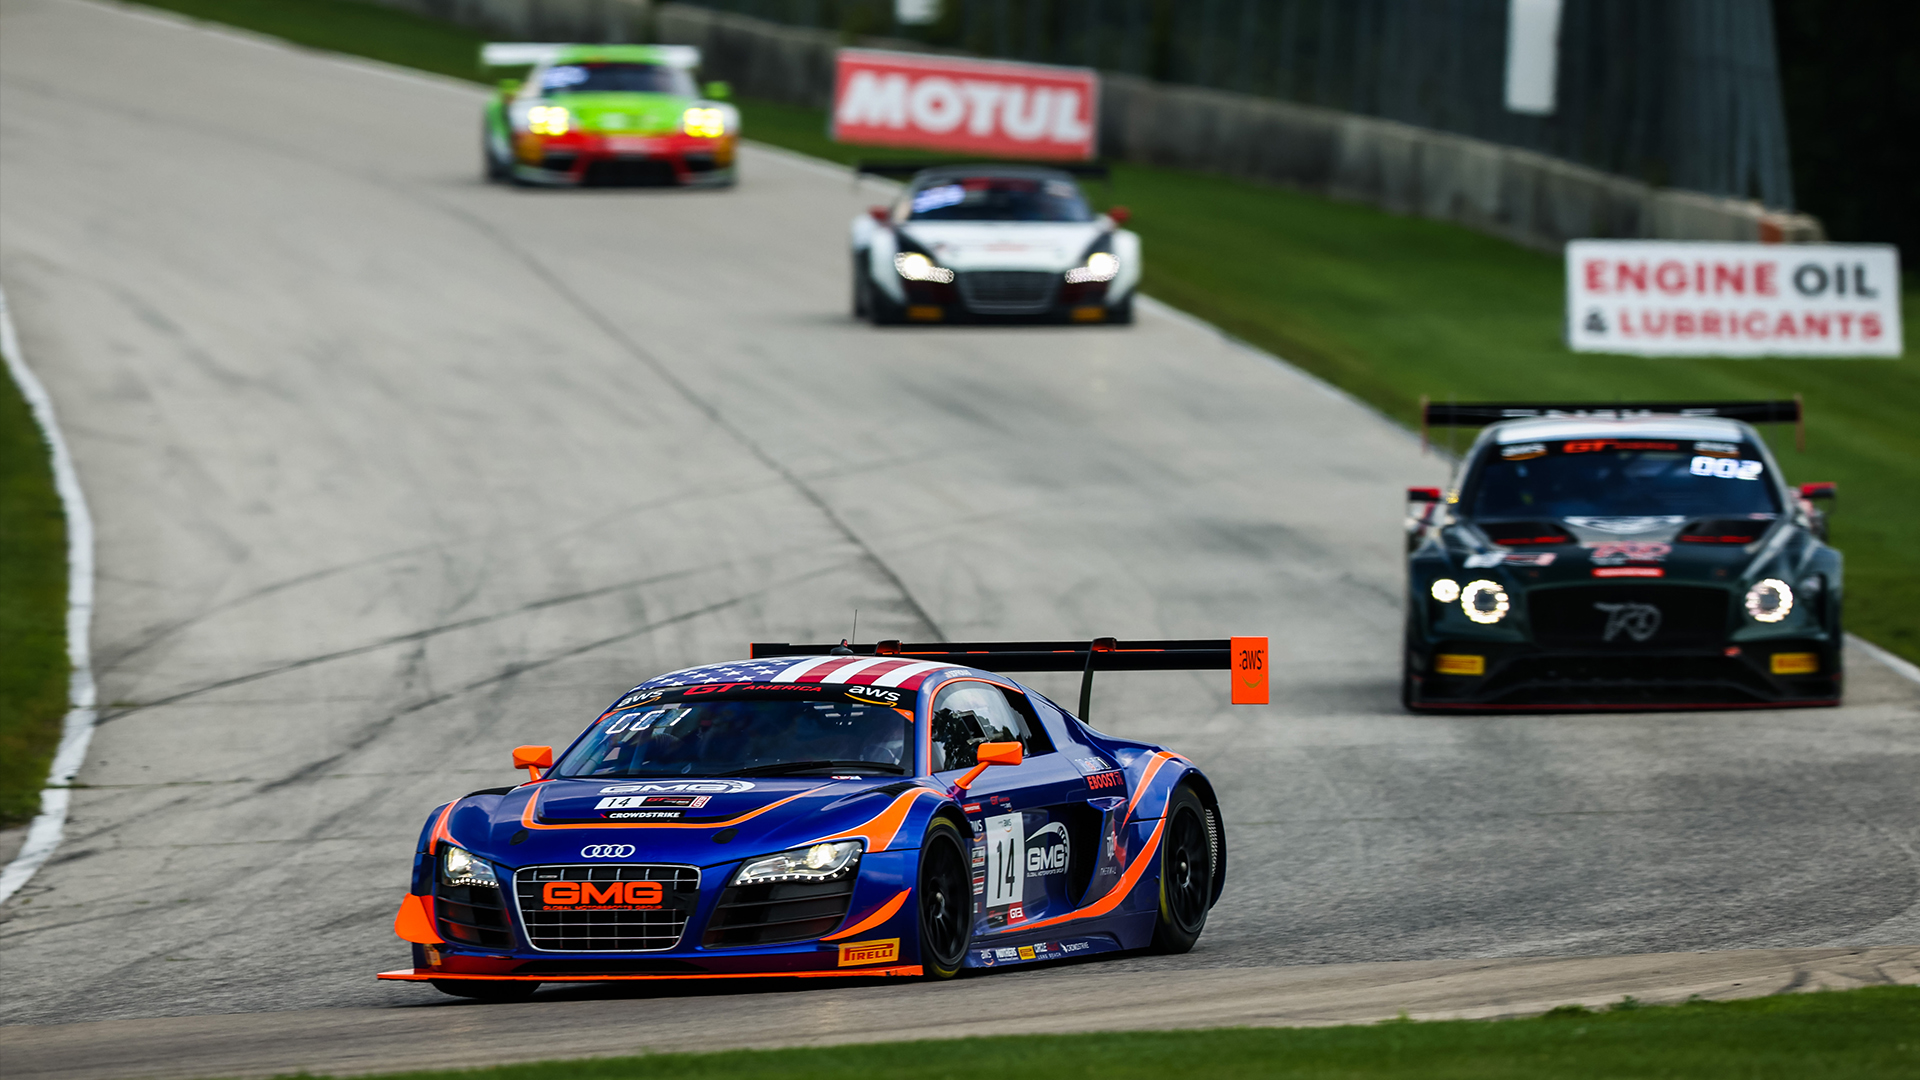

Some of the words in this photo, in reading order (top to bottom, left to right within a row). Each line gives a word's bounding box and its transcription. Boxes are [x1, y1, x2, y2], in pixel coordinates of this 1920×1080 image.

[839, 69, 1091, 142] MOTUL
[1583, 259, 1779, 297] ENGINE
[1793, 262, 1880, 298] OIL
[1583, 309, 1608, 335] &
[1618, 308, 1884, 341] LUBRICANTS
[1690, 456, 1763, 481] 002
[617, 689, 666, 707] aws
[683, 682, 753, 695] GT
[848, 685, 901, 702] aws
[605, 708, 693, 734] 001
[600, 784, 729, 793] GMG
[1087, 772, 1117, 790] EBOOST
[607, 797, 635, 807] 14
[996, 838, 1015, 899] 14
[1027, 844, 1065, 872] GMG
[543, 882, 663, 905] GMG
[844, 943, 894, 961] PIRELLI
